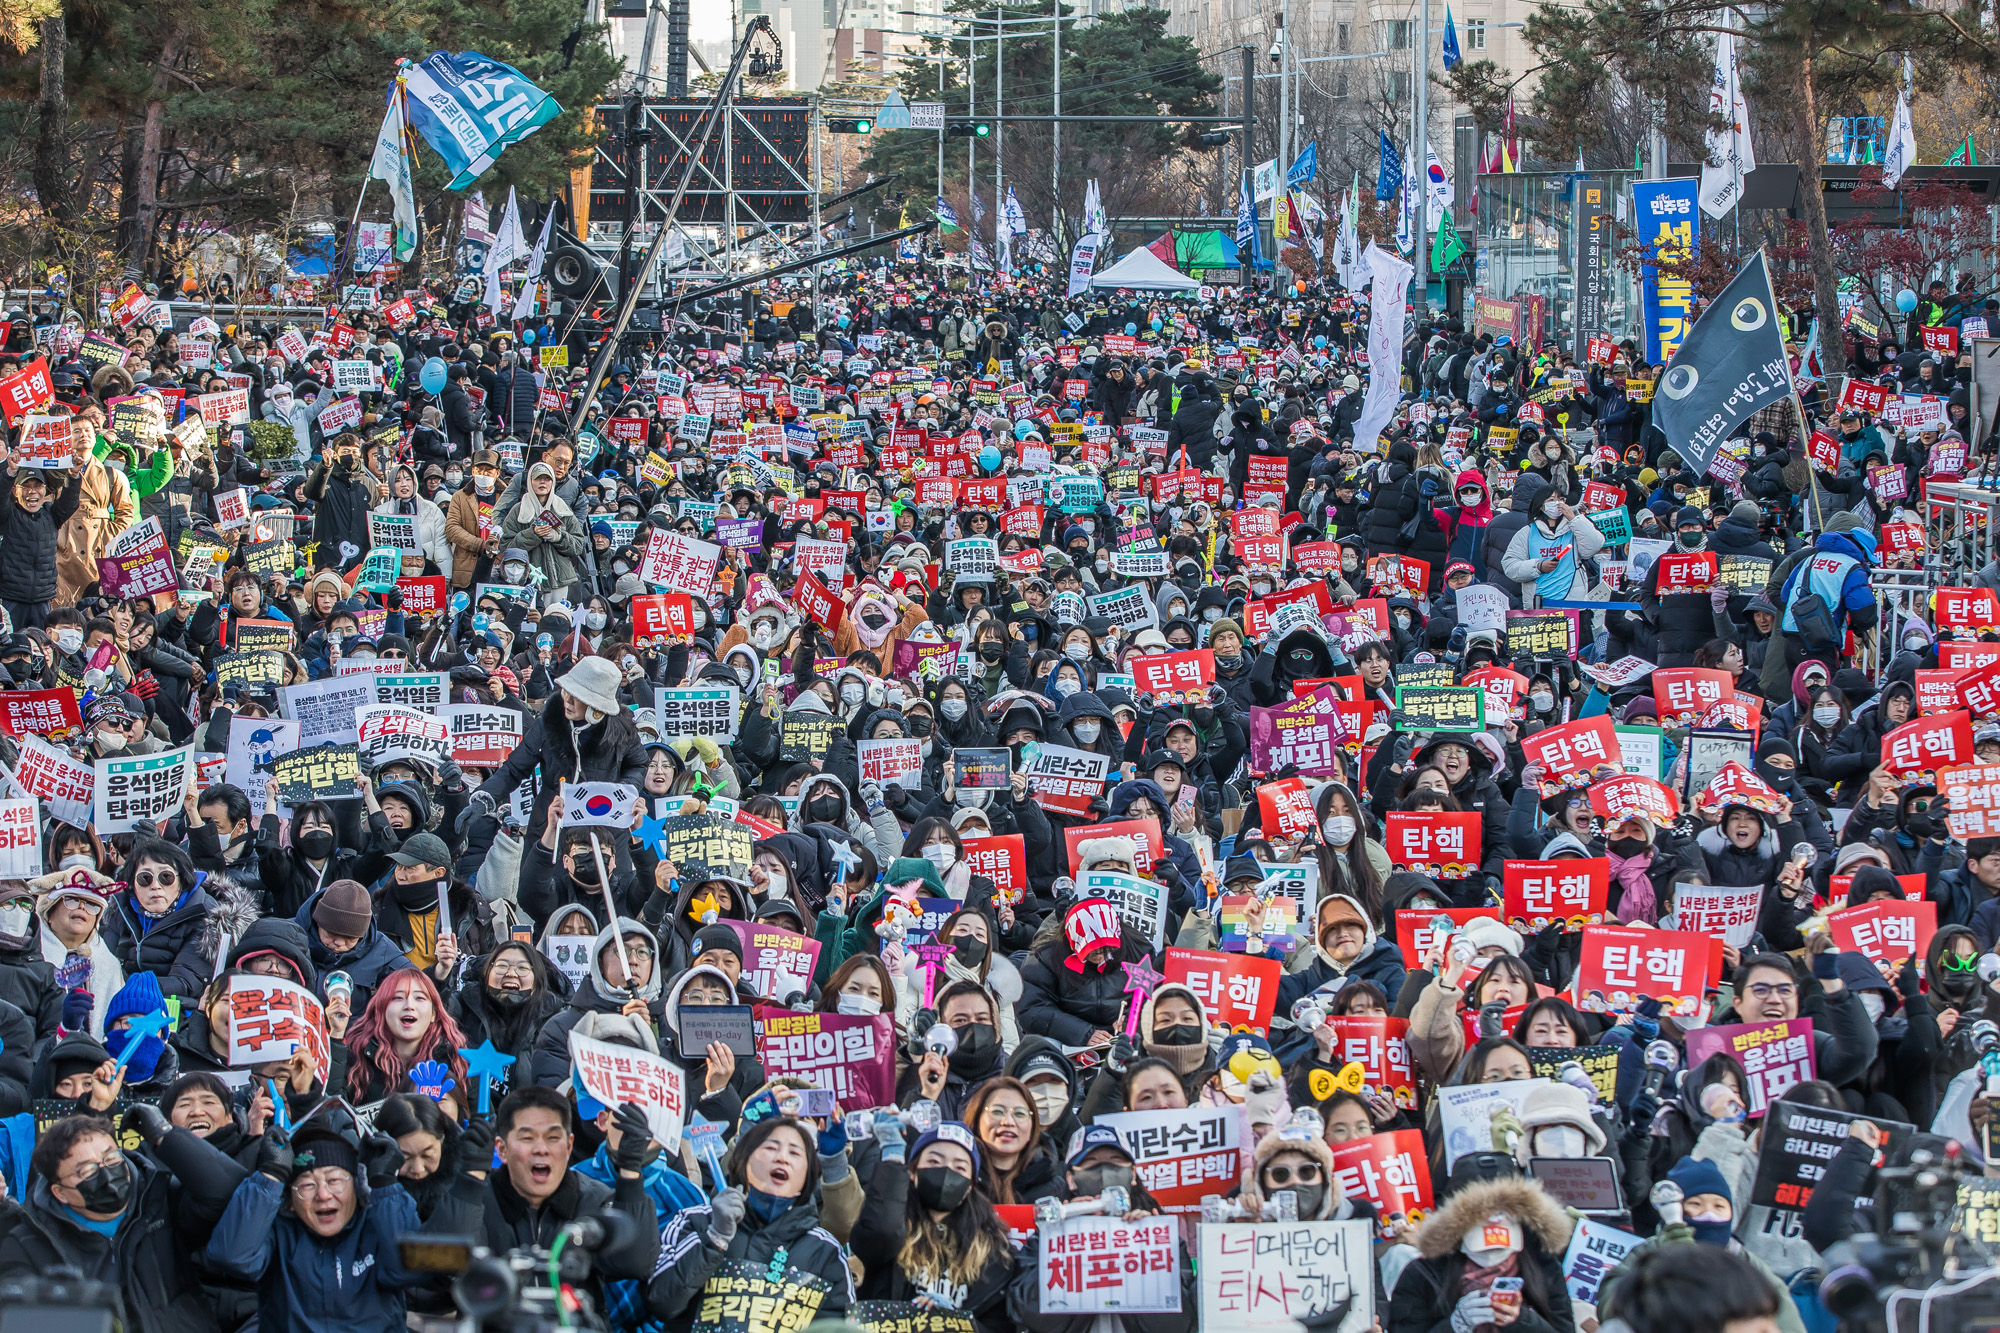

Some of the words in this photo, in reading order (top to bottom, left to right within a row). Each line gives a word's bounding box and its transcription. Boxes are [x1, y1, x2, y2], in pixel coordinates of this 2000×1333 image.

[911, 116, 943, 127] 24:00-05:00
[1650, 198, 1691, 215] 민주당
[1589, 216, 1600, 230] 5
[1588, 233, 1600, 293] 국회의사당
[389, 304, 413, 323] 탄핵
[1924, 331, 1950, 348] 탄핵
[338, 366, 368, 376] 윤석열을
[340, 376, 372, 386] 탄핵하라
[16, 373, 48, 410] 탄핵
[202, 398, 226, 410] 내란범
[228, 392, 248, 404] 윤석열
[1853, 388, 1882, 409] 탄핵
[203, 402, 248, 422] 체포하라
[322, 410, 355, 429] 체포하라
[1902, 411, 1940, 427] 체포하라
[1135, 432, 1165, 441] 내란수괴
[881, 448, 909, 466] 탄핵
[1815, 440, 1838, 465] 탄핵
[1938, 446, 1966, 458] 윤석열
[1932, 458, 1965, 475] 체포!
[922, 482, 953, 491] 윤석열을
[1162, 479, 1178, 487] 빛으로
[1877, 471, 1902, 486] 윤석열
[922, 491, 953, 500] 탄핵하라
[967, 485, 998, 503] 탄핵
[1591, 491, 1619, 508] 탄핵
[1006, 510, 1038, 523] 윤석열을
[1239, 515, 1272, 525] 윤석열을
[372, 524, 414, 538] 윤석열을
[719, 528, 749, 538] 윤석열을
[1007, 520, 1039, 534] 탄핵하라
[1240, 523, 1273, 535] 탄핵하라
[373, 536, 417, 550] 탄핵하라
[653, 533, 689, 556] 역사는
[1891, 529, 1922, 549] 탄핵
[798, 545, 821, 553] 내란범
[822, 545, 844, 554] 윤석열
[950, 547, 996, 562] 윤석열을
[1244, 541, 1281, 564] 탄핵
[1298, 551, 1318, 560] 빛으로
[121, 554, 154, 571] 반란수괴
[128, 558, 167, 580] 윤석열
[796, 554, 843, 568] 체포하라
[950, 561, 997, 575] 탄핵하라
[1006, 552, 1041, 568] 탄핵
[1322, 559, 1341, 567] 모이자
[651, 563, 676, 584] 잊지
[1669, 560, 1711, 584] 탄핵
[1721, 570, 1771, 588] 즉각탄핵
[119, 573, 174, 601] 체포!
[801, 581, 832, 620] 탄핵
[1096, 594, 1144, 617] 윤석열을
[1948, 597, 1993, 624] 탄핵
[646, 607, 686, 633] 탄핵
[1508, 625, 1536, 636] 내란수괴
[1544, 621, 1568, 632] 윤석열
[1508, 632, 1568, 653] 즉각탄핵
[217, 659, 250, 674] 내란수괴
[259, 658, 282, 669] 윤석열
[217, 664, 283, 688] 즉각탄핵
[1147, 663, 1202, 689] 탄핵
[377, 686, 441, 704] 윤석열을
[1403, 696, 1440, 707] 내란수괴
[1449, 694, 1476, 704] 윤석열
[1668, 681, 1721, 709] 탄핵
[8, 698, 63, 719] 윤석열을
[664, 700, 731, 719] 윤석열을
[1403, 699, 1477, 720] 즉각탄핵
[11, 715, 67, 734] 탄핵하라
[363, 716, 444, 741] 윤석열을
[451, 712, 515, 733] 내란수괴
[664, 719, 731, 736] 탄핵하라
[783, 721, 816, 731] 내란수괴
[1276, 718, 1316, 728] 반란수괴
[1281, 725, 1329, 745] 윤석열
[369, 735, 450, 757] 탄핵하자
[862, 748, 892, 762] 내란범
[894, 744, 921, 757] 윤석열
[1541, 733, 1607, 774] 탄핵
[1892, 727, 1956, 768] 탄핵
[24, 746, 57, 771] 내란범
[58, 762, 95, 787] 윤석열
[274, 755, 315, 771] 내란수괴
[326, 752, 357, 762] 윤석열
[862, 757, 922, 782] 체포하라
[1034, 755, 1103, 779] 내란수괴
[1269, 747, 1330, 773] 체포!
[107, 764, 185, 797] 윤석열을
[275, 760, 359, 789] 즉각탄핵
[1711, 769, 1770, 797] 탄핵
[15, 769, 93, 806] 체포하라
[1069, 780, 1102, 797] 탄핵!
[1604, 782, 1665, 800] 윤석열을
[106, 787, 182, 821] 탄핵하라
[1948, 811, 1985, 834] 탄핵
[669, 825, 711, 844] 내란수괴
[722, 830, 750, 843] 윤석열
[1402, 826, 1464, 860] 탄핵
[670, 839, 752, 867] 즉각탄핵
[1522, 873, 1591, 913] 탄핵
[1680, 895, 1719, 911] 내란범
[1722, 892, 1760, 909] 윤석열
[1678, 909, 1757, 939] 체포하라
[753, 932, 803, 951] 반란수괴
[1851, 916, 1916, 958] 탄핵
[758, 948, 812, 973] 윤석열
[1602, 944, 1686, 991] 탄핵
[1186, 969, 1261, 1021] 탄핵
[694, 1030, 713, 1040] 탄핵
[715, 1031, 742, 1040] D-day
[764, 1015, 821, 1037] 내란공범
[766, 1024, 876, 1065] 국민의힘
[1732, 1023, 1790, 1052] 반란수괴
[1344, 1036, 1412, 1081] 탄핵
[1743, 1034, 1809, 1073] 윤석열
[580, 1048, 633, 1074] 내란범
[636, 1059, 680, 1090] 윤석열
[584, 1065, 682, 1117] 체포하라
[1179, 1154, 1235, 1187] 탄핵!
[1341, 1152, 1421, 1209] 탄핵
[1048, 1233, 1107, 1254] 내란범
[1111, 1225, 1171, 1249] 윤석열
[1047, 1247, 1175, 1294] 체포하라
[705, 1276, 766, 1296] 내란수괴
